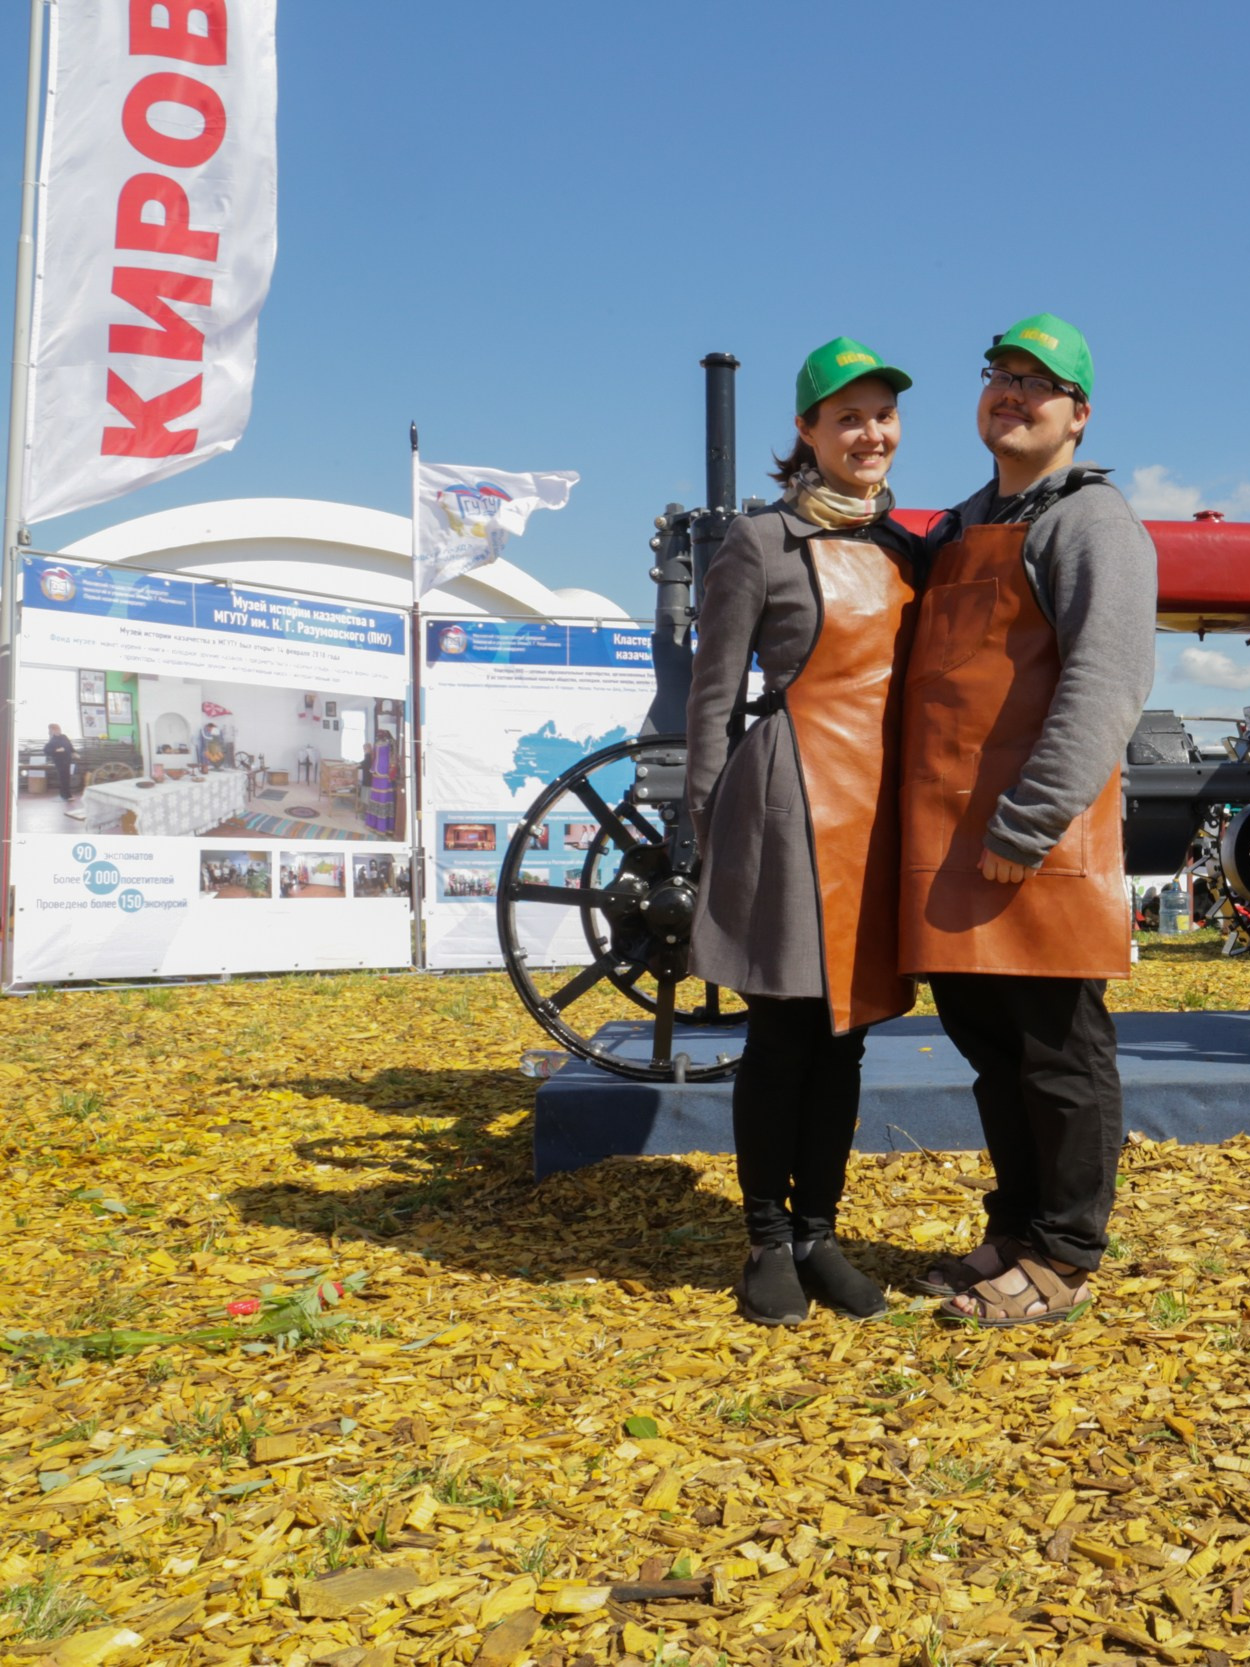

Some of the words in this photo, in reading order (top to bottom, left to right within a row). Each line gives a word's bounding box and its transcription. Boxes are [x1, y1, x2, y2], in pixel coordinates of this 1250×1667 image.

[100, 0, 228, 459] КИРОВ
[232, 594, 267, 613] Музей
[269, 602, 311, 621] истории
[313, 609, 367, 627] казачества
[368, 618, 376, 628] в
[213, 609, 249, 627] МГУТУ
[250, 617, 270, 630] им.
[271, 618, 283, 631] К.
[285, 620, 296, 634] Г.
[297, 621, 365, 643] Разумовского
[366, 630, 393, 648] (ПКУ)
[76, 845, 93, 860] 90
[103, 851, 154, 861] экспонатов
[53, 873, 81, 884] Более
[120, 874, 175, 885] посетителей
[36, 898, 88, 910] Проведено
[91, 898, 117, 909] более
[121, 894, 142, 909] 150
[144, 898, 188, 911] экскурсий
